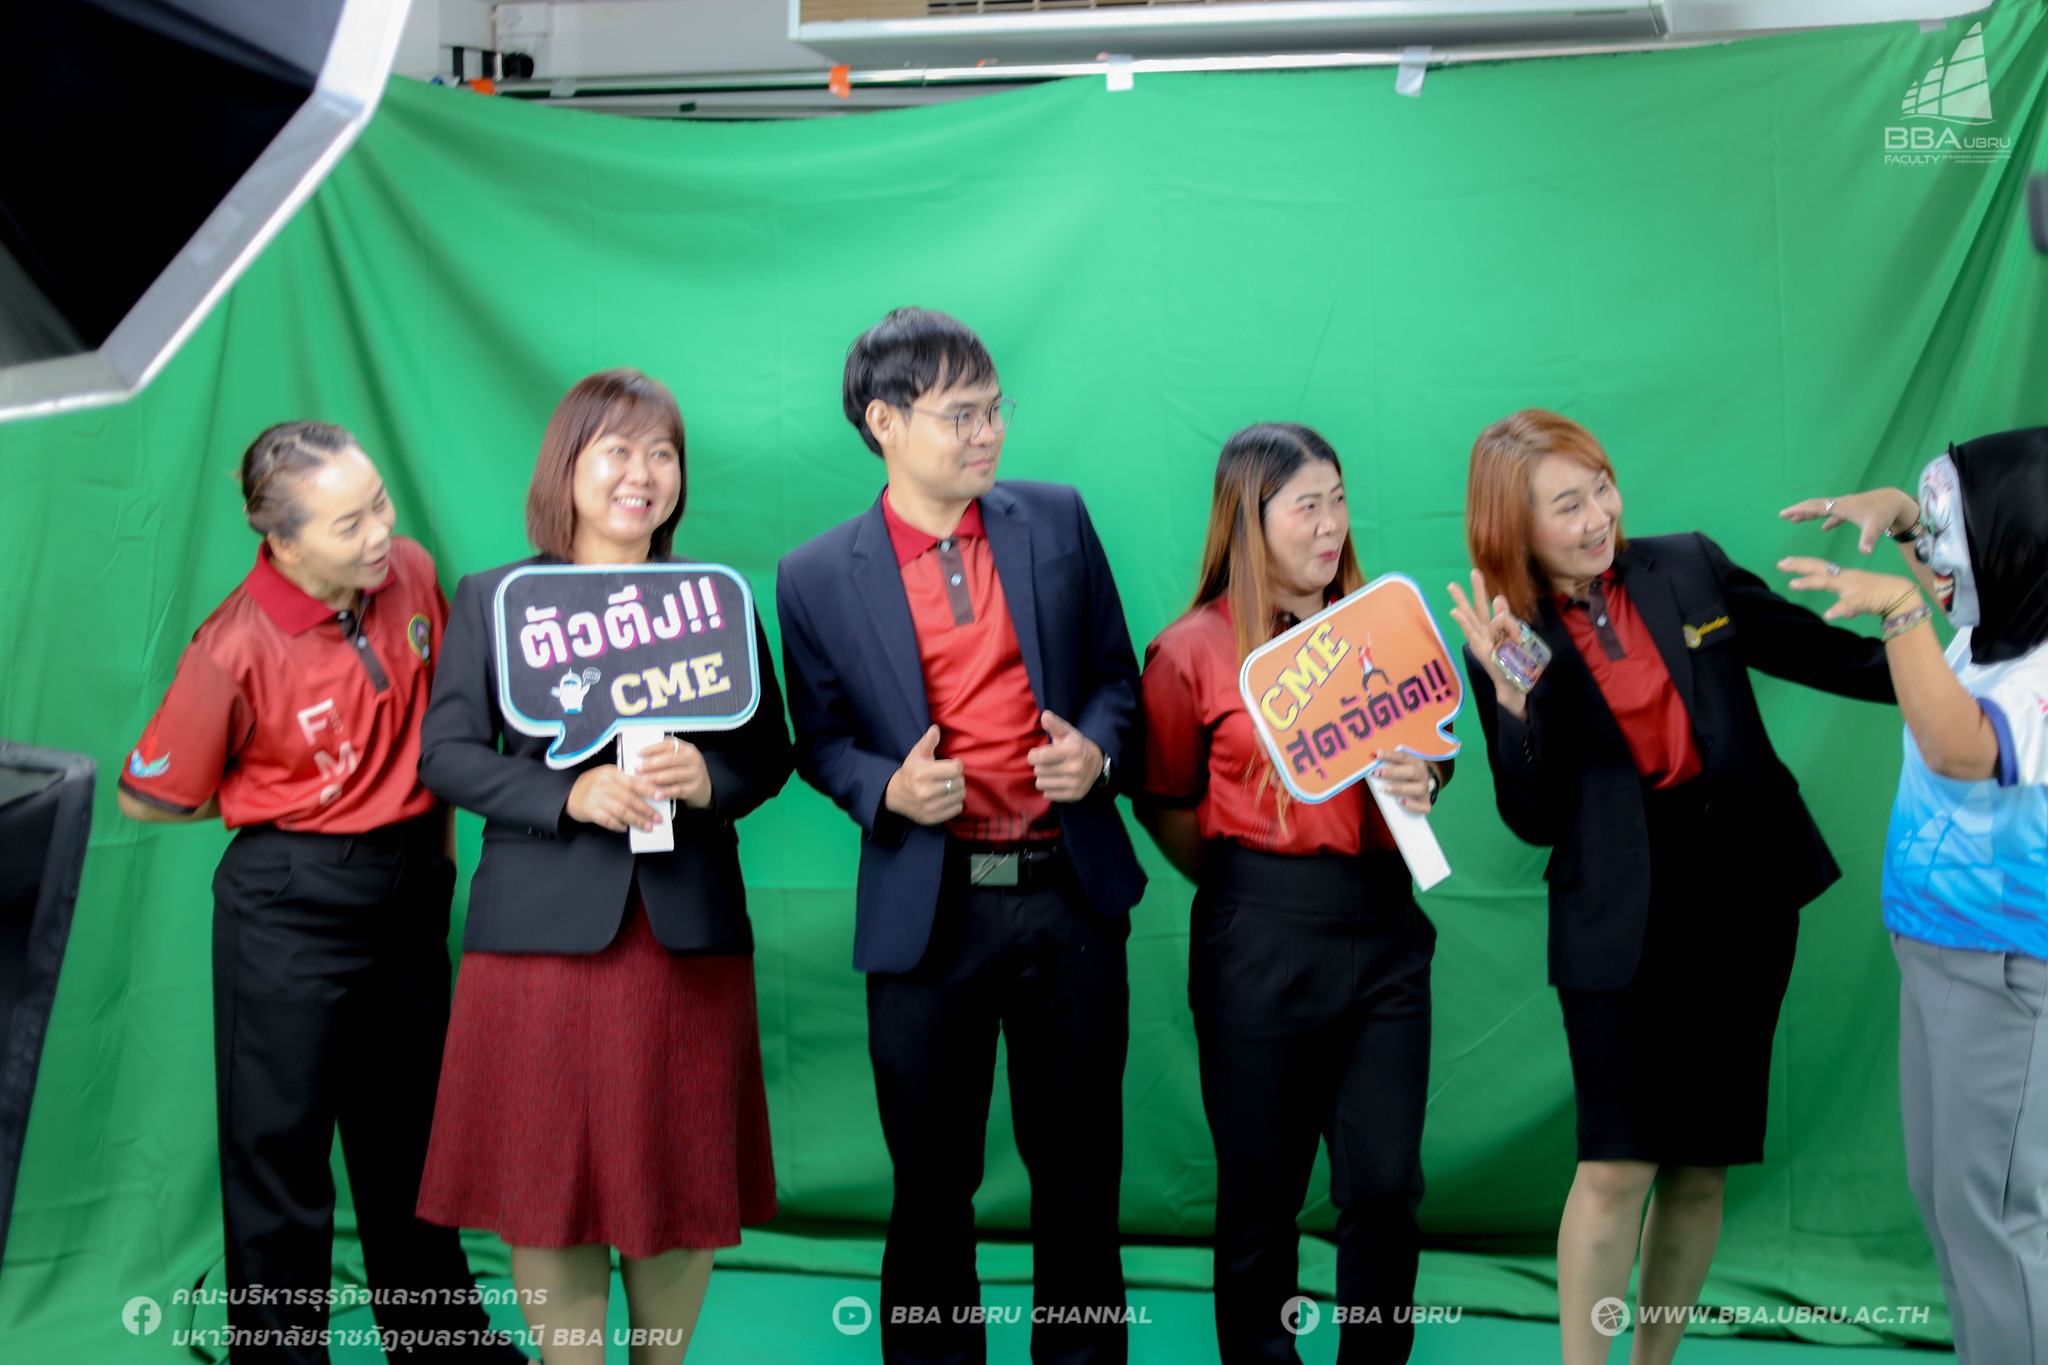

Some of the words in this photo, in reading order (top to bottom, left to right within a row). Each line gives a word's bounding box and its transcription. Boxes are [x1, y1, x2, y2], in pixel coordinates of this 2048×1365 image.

[518, 576, 728, 670] ตัวตึง!!
[610, 651, 732, 716] CME
[1260, 620, 1351, 732] CME
